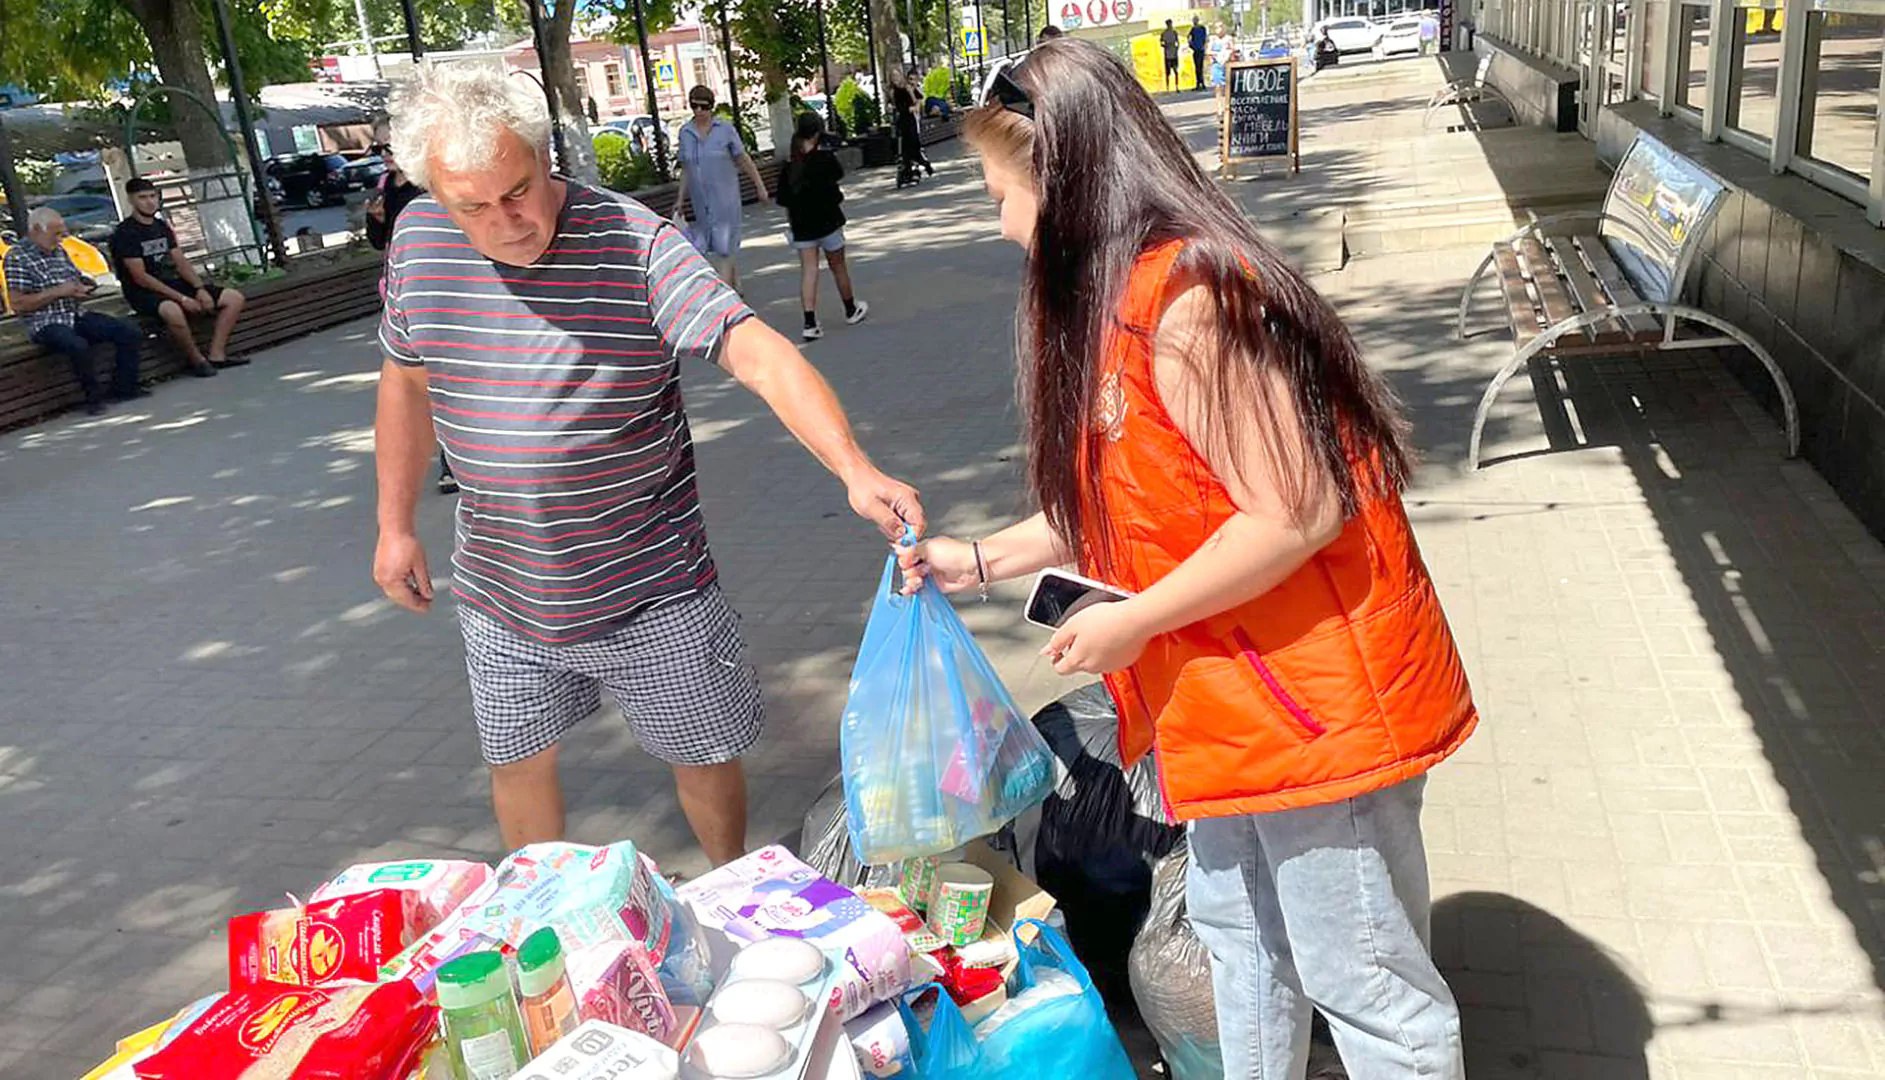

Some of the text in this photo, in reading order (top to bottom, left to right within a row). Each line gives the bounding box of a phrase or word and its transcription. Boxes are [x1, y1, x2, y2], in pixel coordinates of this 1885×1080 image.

[1234, 66, 1289, 92] НОВОЕ
[1243, 119, 1288, 132] МЕБЕЛЬ
[870, 1041, 886, 1069] tafo
